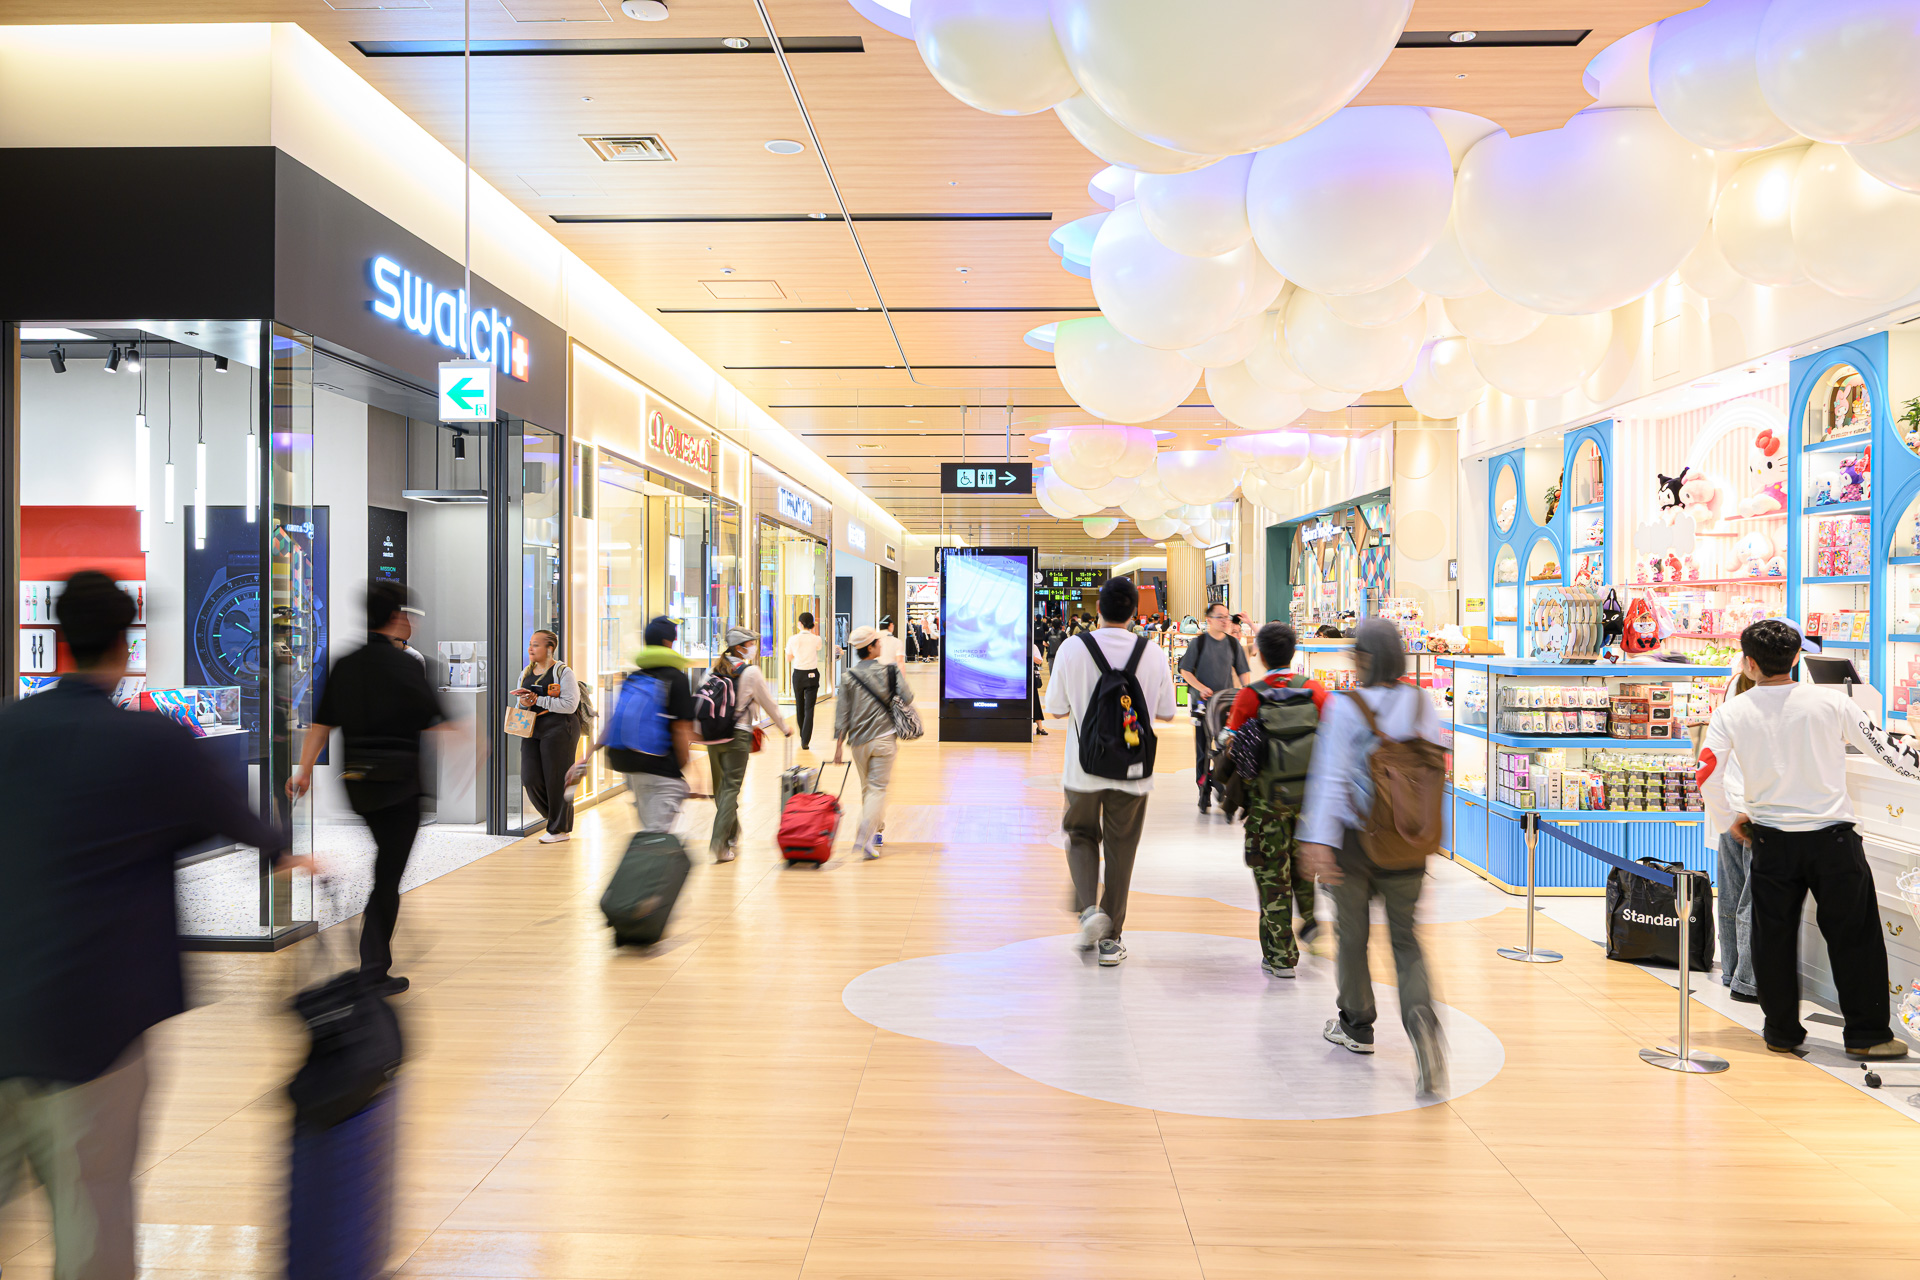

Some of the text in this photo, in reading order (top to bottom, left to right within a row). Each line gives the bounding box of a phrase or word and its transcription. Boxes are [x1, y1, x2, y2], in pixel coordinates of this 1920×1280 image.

[374, 256, 511, 375] swatch
[1858, 721, 1885, 754] COMME
[1882, 754, 1897, 768] des
